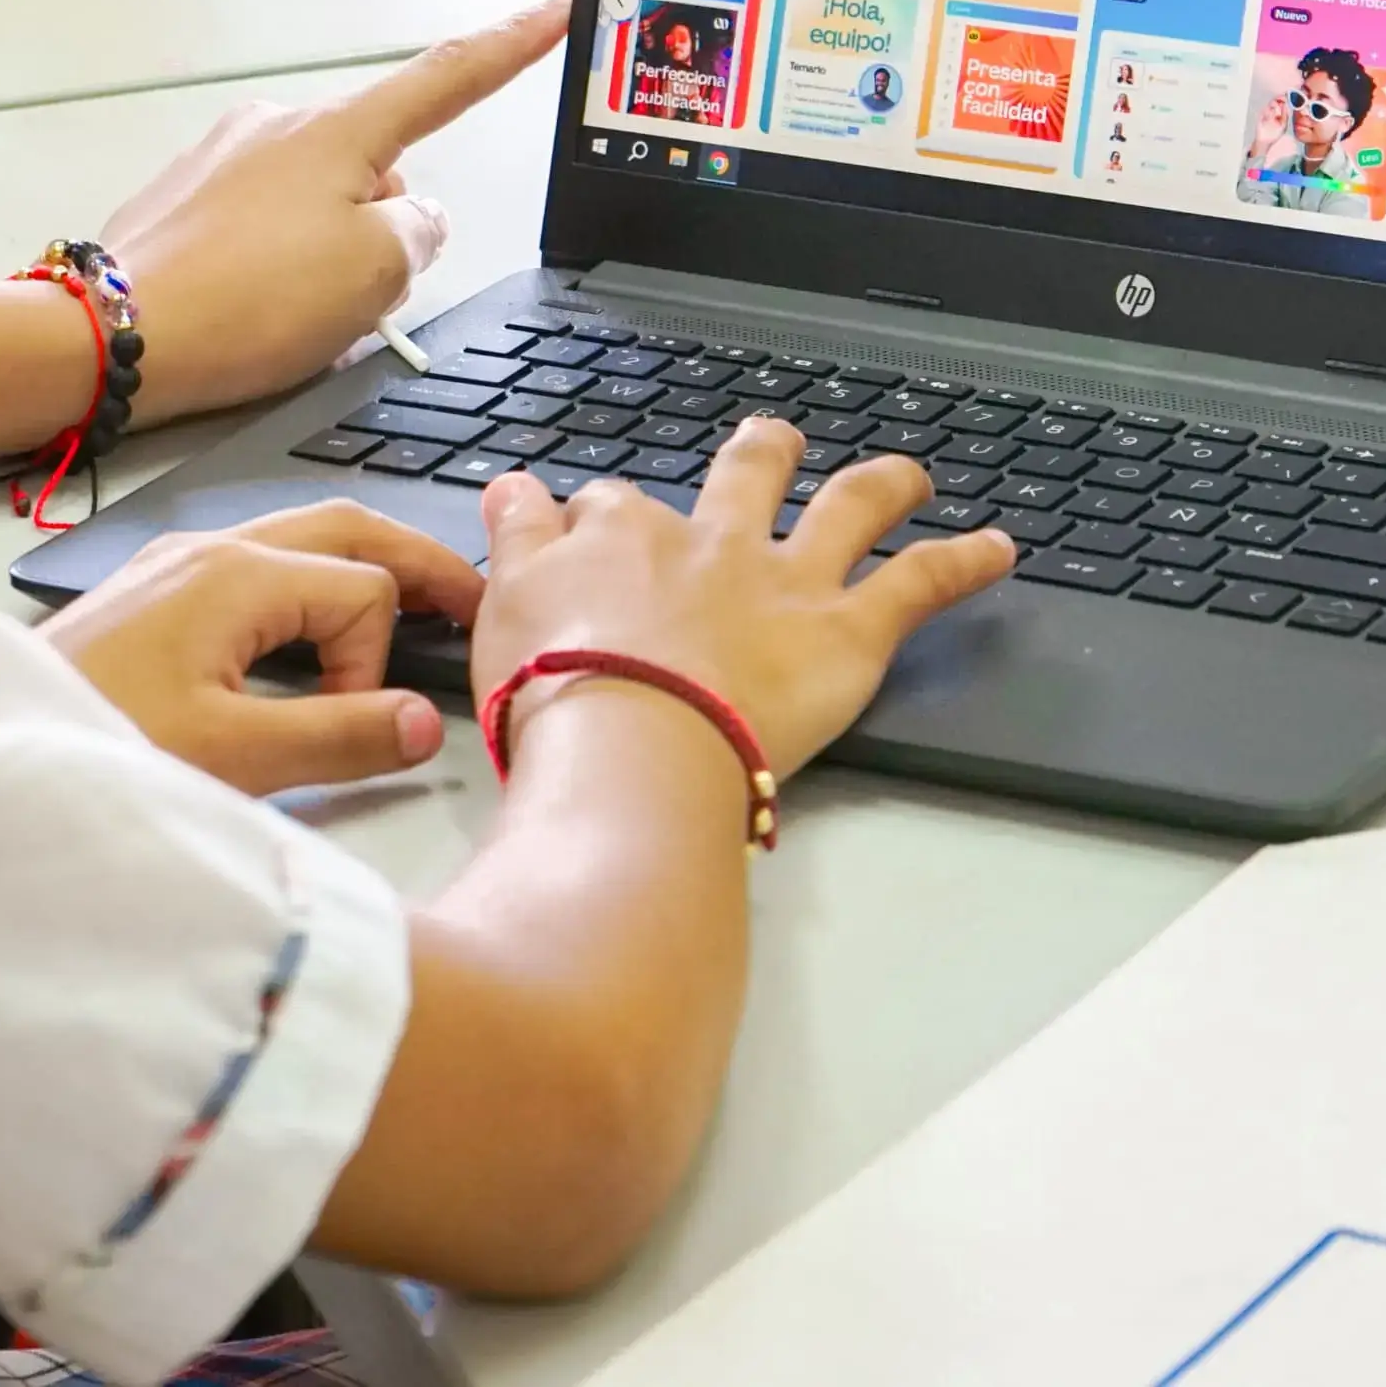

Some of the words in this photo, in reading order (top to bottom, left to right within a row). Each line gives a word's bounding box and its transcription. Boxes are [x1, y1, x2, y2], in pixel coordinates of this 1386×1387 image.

[1274, 9, 1308, 22] Nuevo
[809, 27, 892, 54] equipo!
[790, 61, 827, 76] Temario
[966, 58, 1057, 88] Presenta
[634, 61, 726, 88] Perfecciona
[672, 81, 689, 95] tu
[963, 81, 1001, 98] con
[633, 90, 721, 114] publicación
[962, 94, 1048, 125] facilidad
[1118, 274, 1154, 317] hp
[620, 357, 640, 366] 2
[690, 367, 710, 377] 3
[760, 378, 779, 388] 4
[611, 384, 643, 397] W
[829, 389, 851, 399] 5
[681, 397, 707, 408] E
[901, 401, 922, 411] 6
[588, 414, 612, 425] S
[974, 413, 994, 422] 7
[828, 419, 849, 429] T
[655, 425, 680, 436] D
[900, 430, 922, 441] Y
[1045, 425, 1066, 435] 8
[510, 434, 535, 445] Z
[1119, 436, 1139, 447] 9
[578, 445, 606, 457] X
[803, 448, 825, 460] G
[968, 443, 994, 454] U
[652, 458, 677, 469] C
[947, 473, 971, 484] J
[794, 480, 819, 492] B
[1189, 479, 1213, 490] P
[1018, 484, 1046, 497] K
[1095, 497, 1110, 509] L
[939, 505, 971, 518] M
[1168, 506, 1198, 523] Ñ
